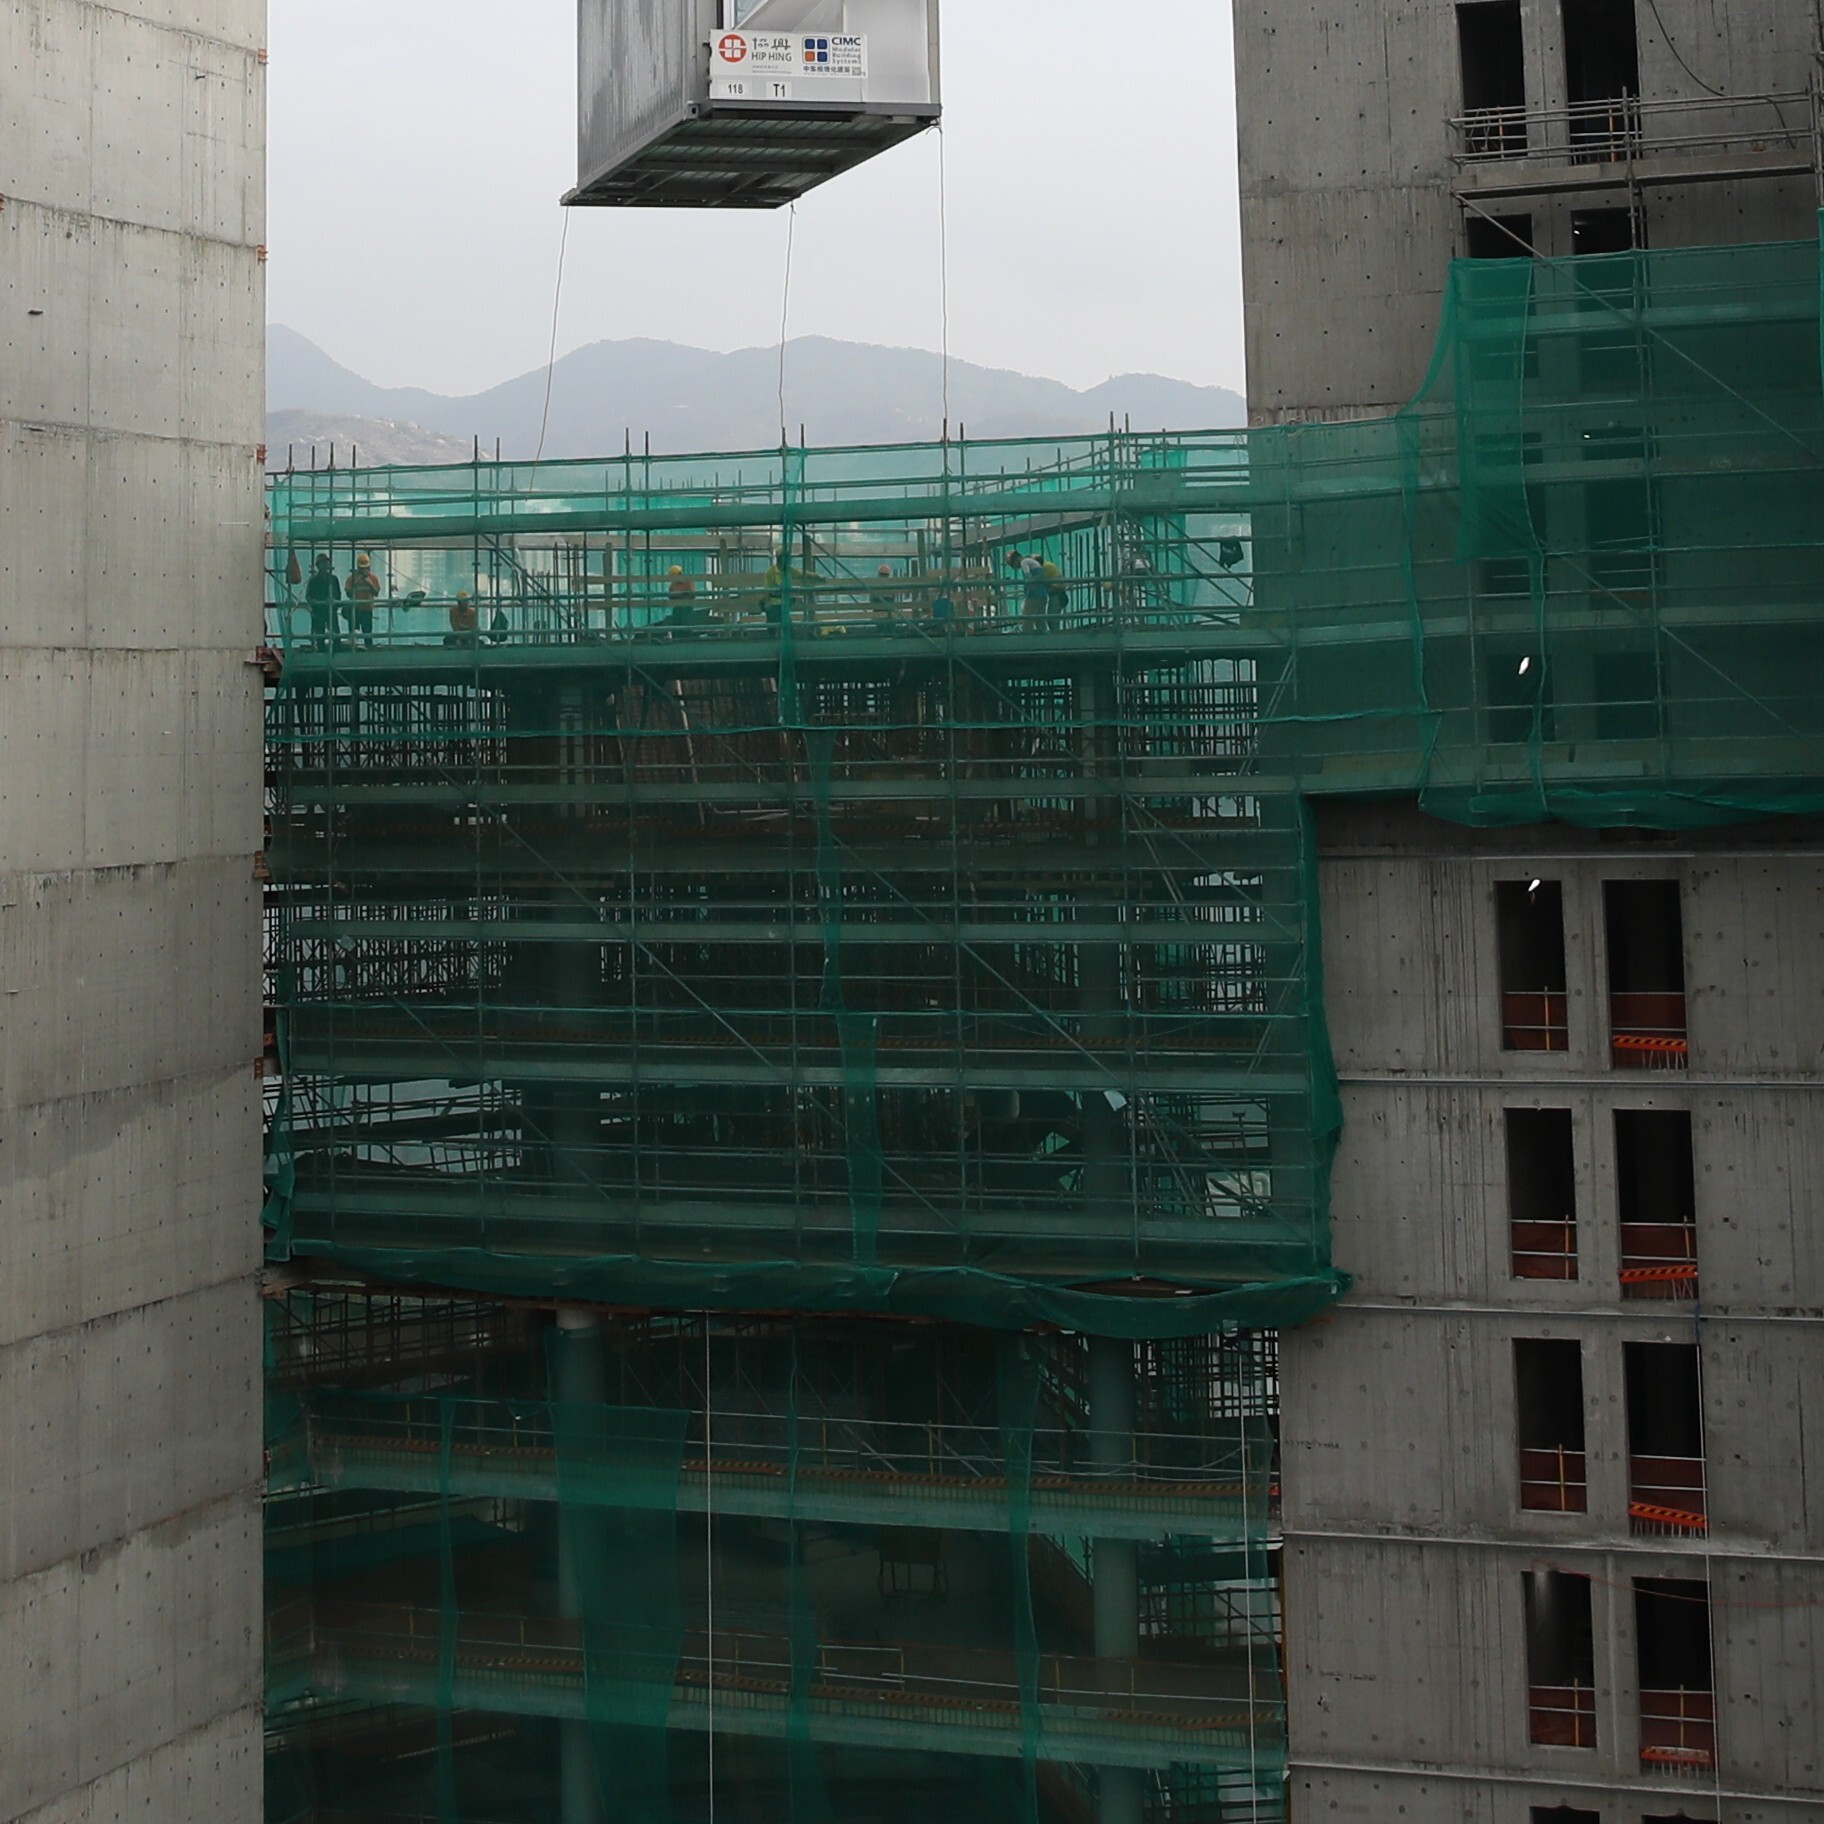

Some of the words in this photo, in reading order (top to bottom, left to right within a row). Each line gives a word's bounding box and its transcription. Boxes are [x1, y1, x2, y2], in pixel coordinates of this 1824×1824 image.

[831, 36, 862, 46] CIMC
[728, 83, 743, 94] 118
[773, 83, 786, 97] T1
